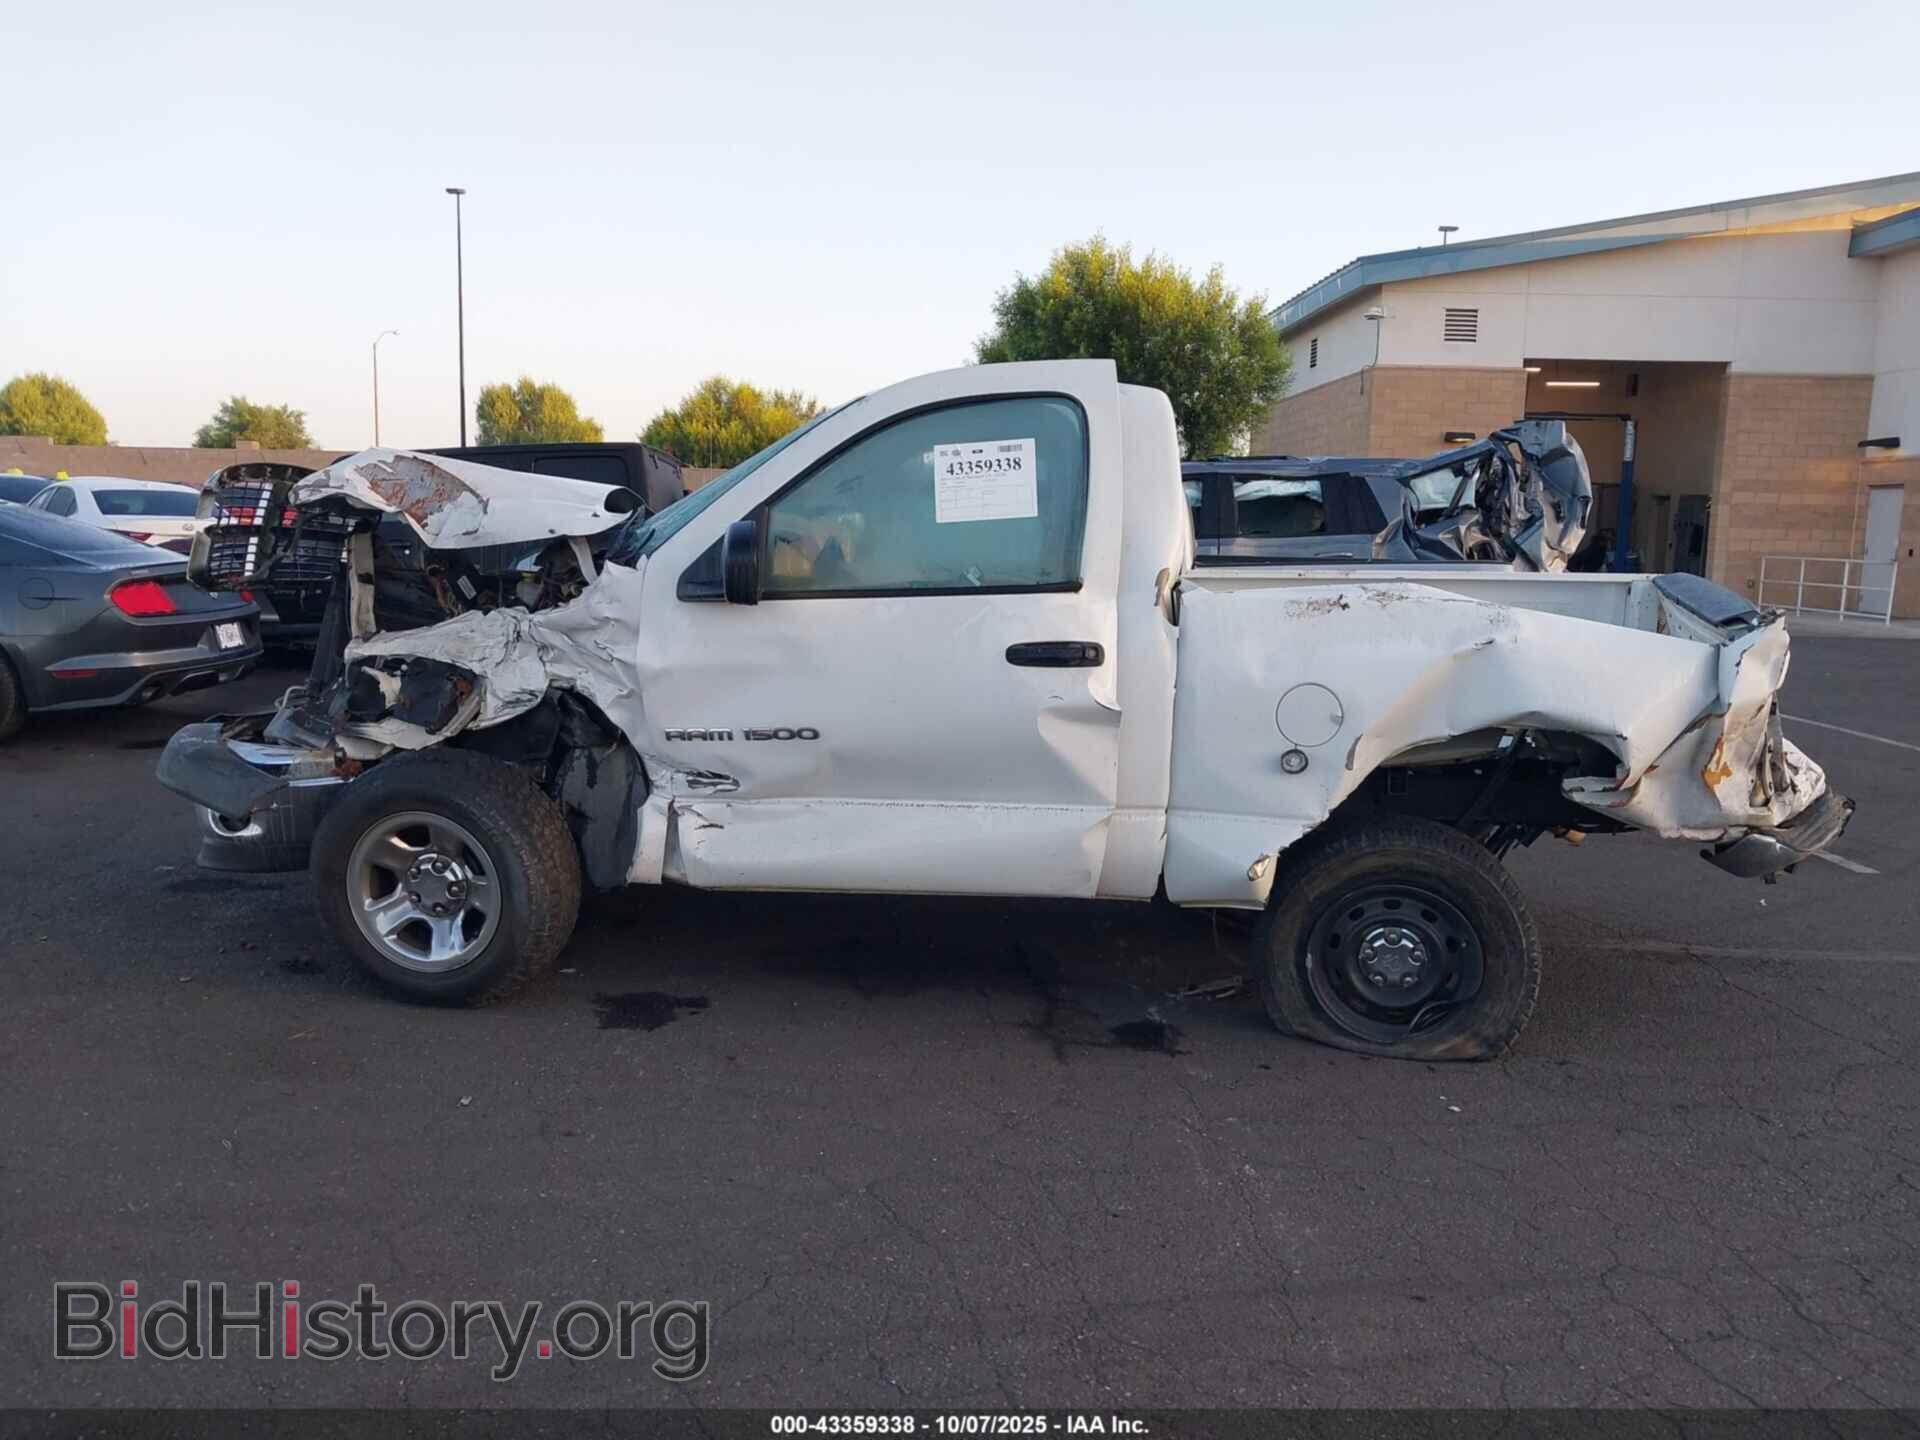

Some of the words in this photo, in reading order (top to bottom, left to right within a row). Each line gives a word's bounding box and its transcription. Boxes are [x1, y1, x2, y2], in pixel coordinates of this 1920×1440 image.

[946, 457, 1021, 475] 43359338
[664, 728, 733, 741] RAM
[744, 728, 820, 741] 1500
